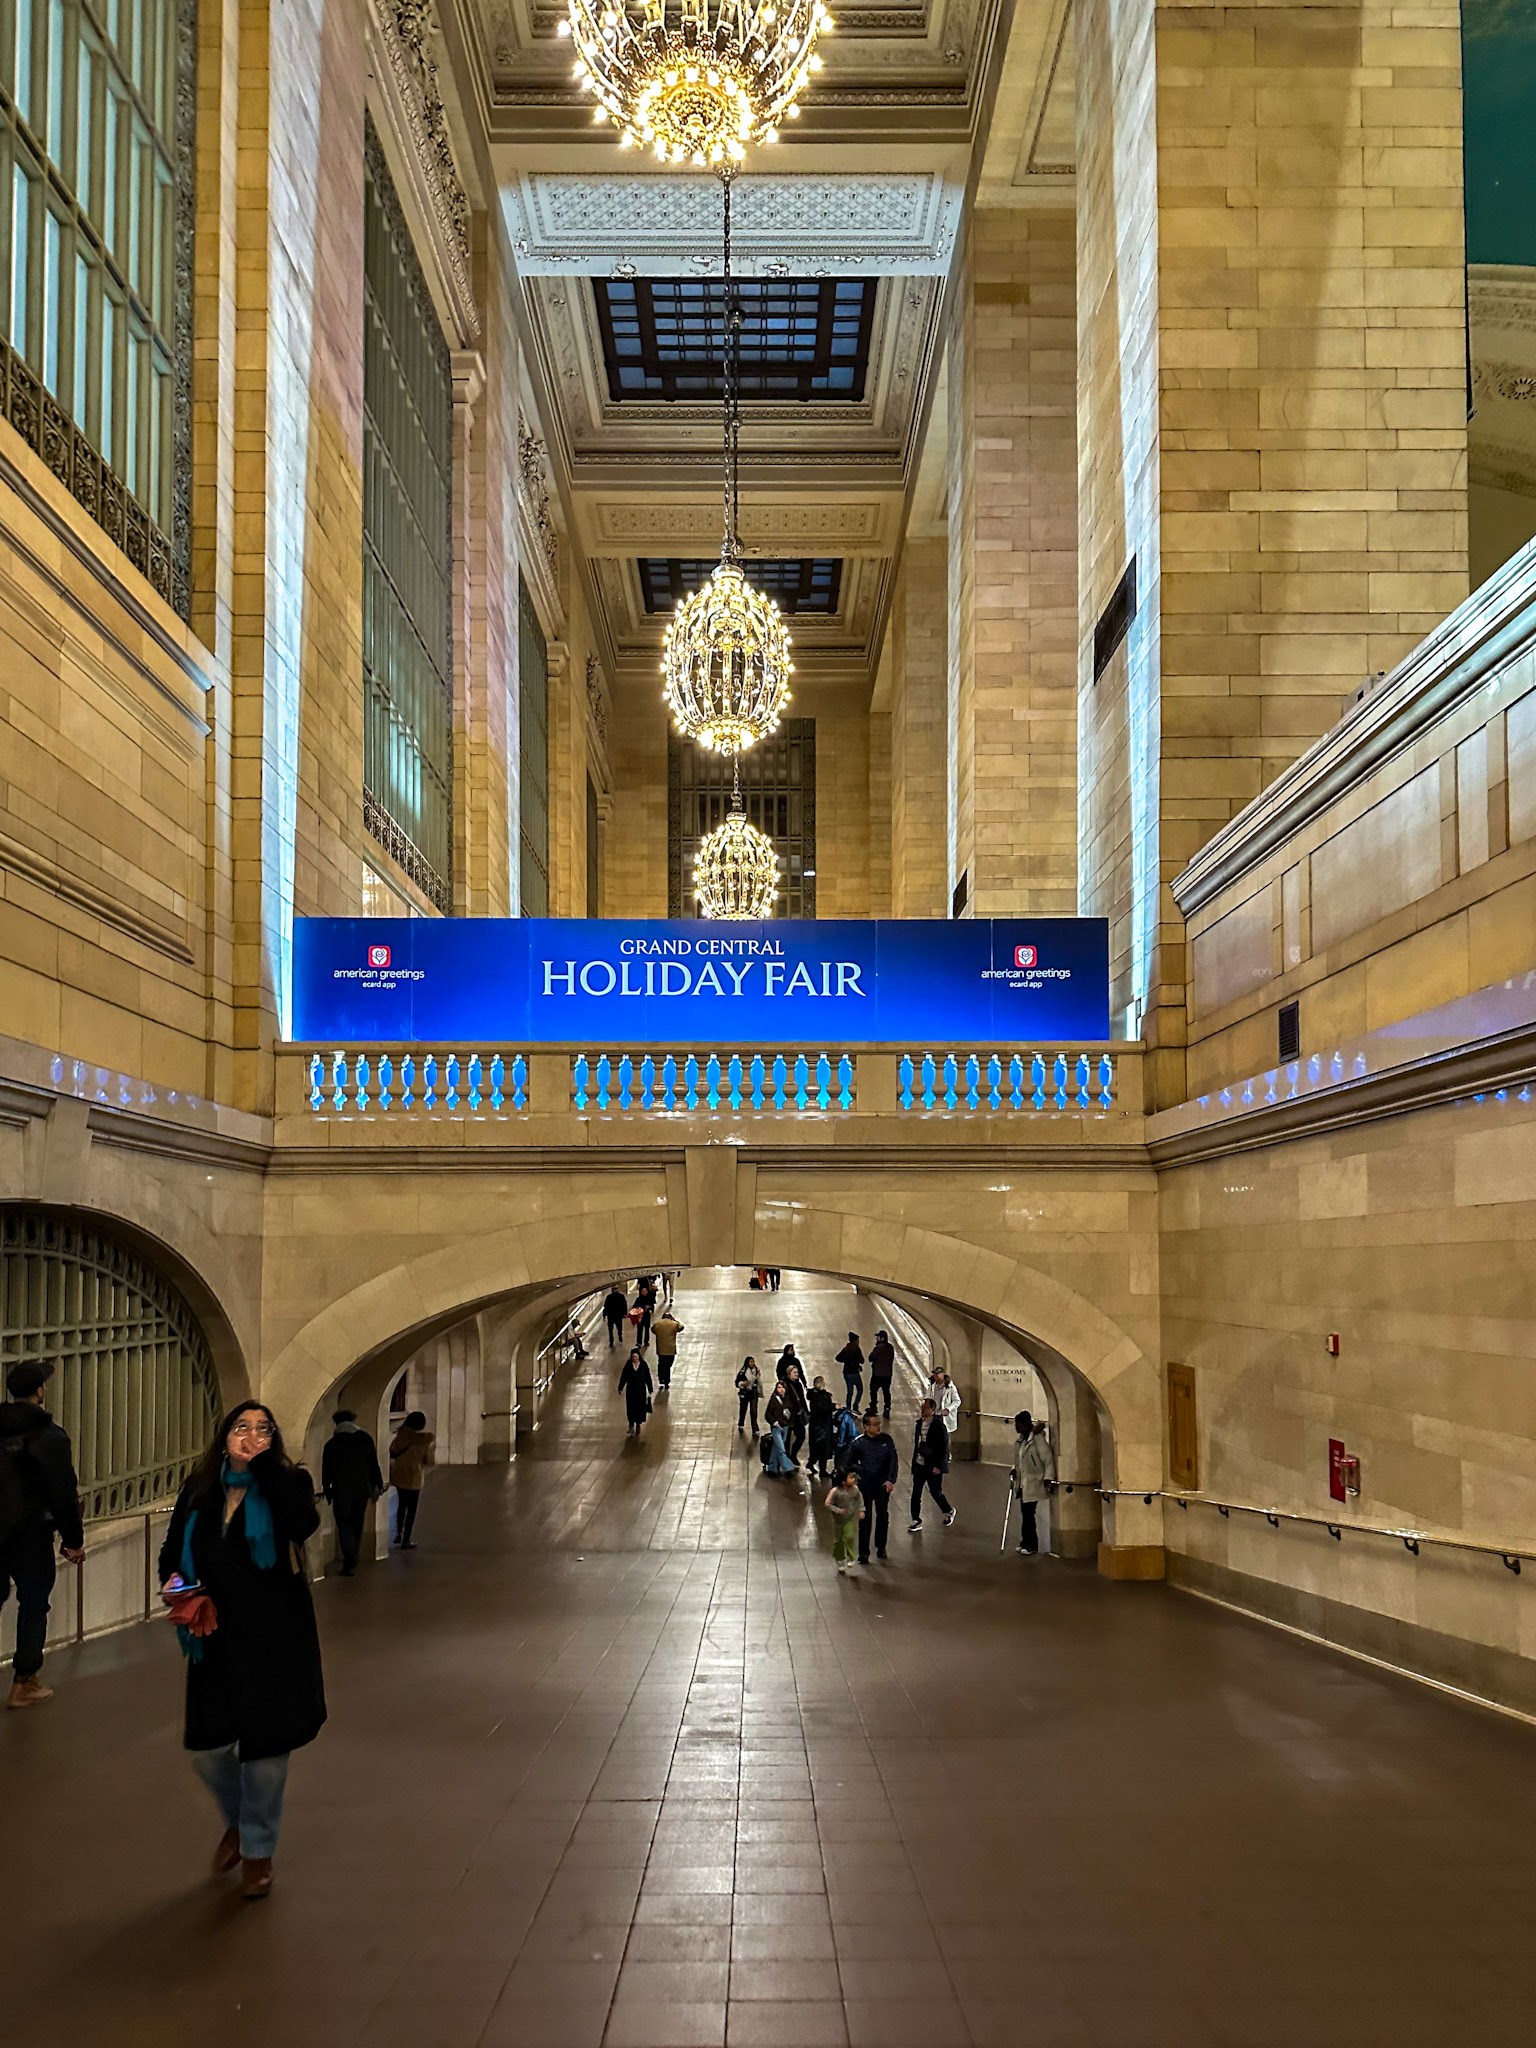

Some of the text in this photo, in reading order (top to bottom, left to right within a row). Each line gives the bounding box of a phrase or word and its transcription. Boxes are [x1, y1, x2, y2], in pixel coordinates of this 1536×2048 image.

[619, 939, 785, 955] GRAND CENTRAL
[333, 967, 425, 981] american greetings
[542, 961, 867, 997] HOLIDAY FAIR
[981, 967, 1071, 980] american greetings
[362, 981, 397, 991] ecard app
[1009, 981, 1043, 990] ecard app
